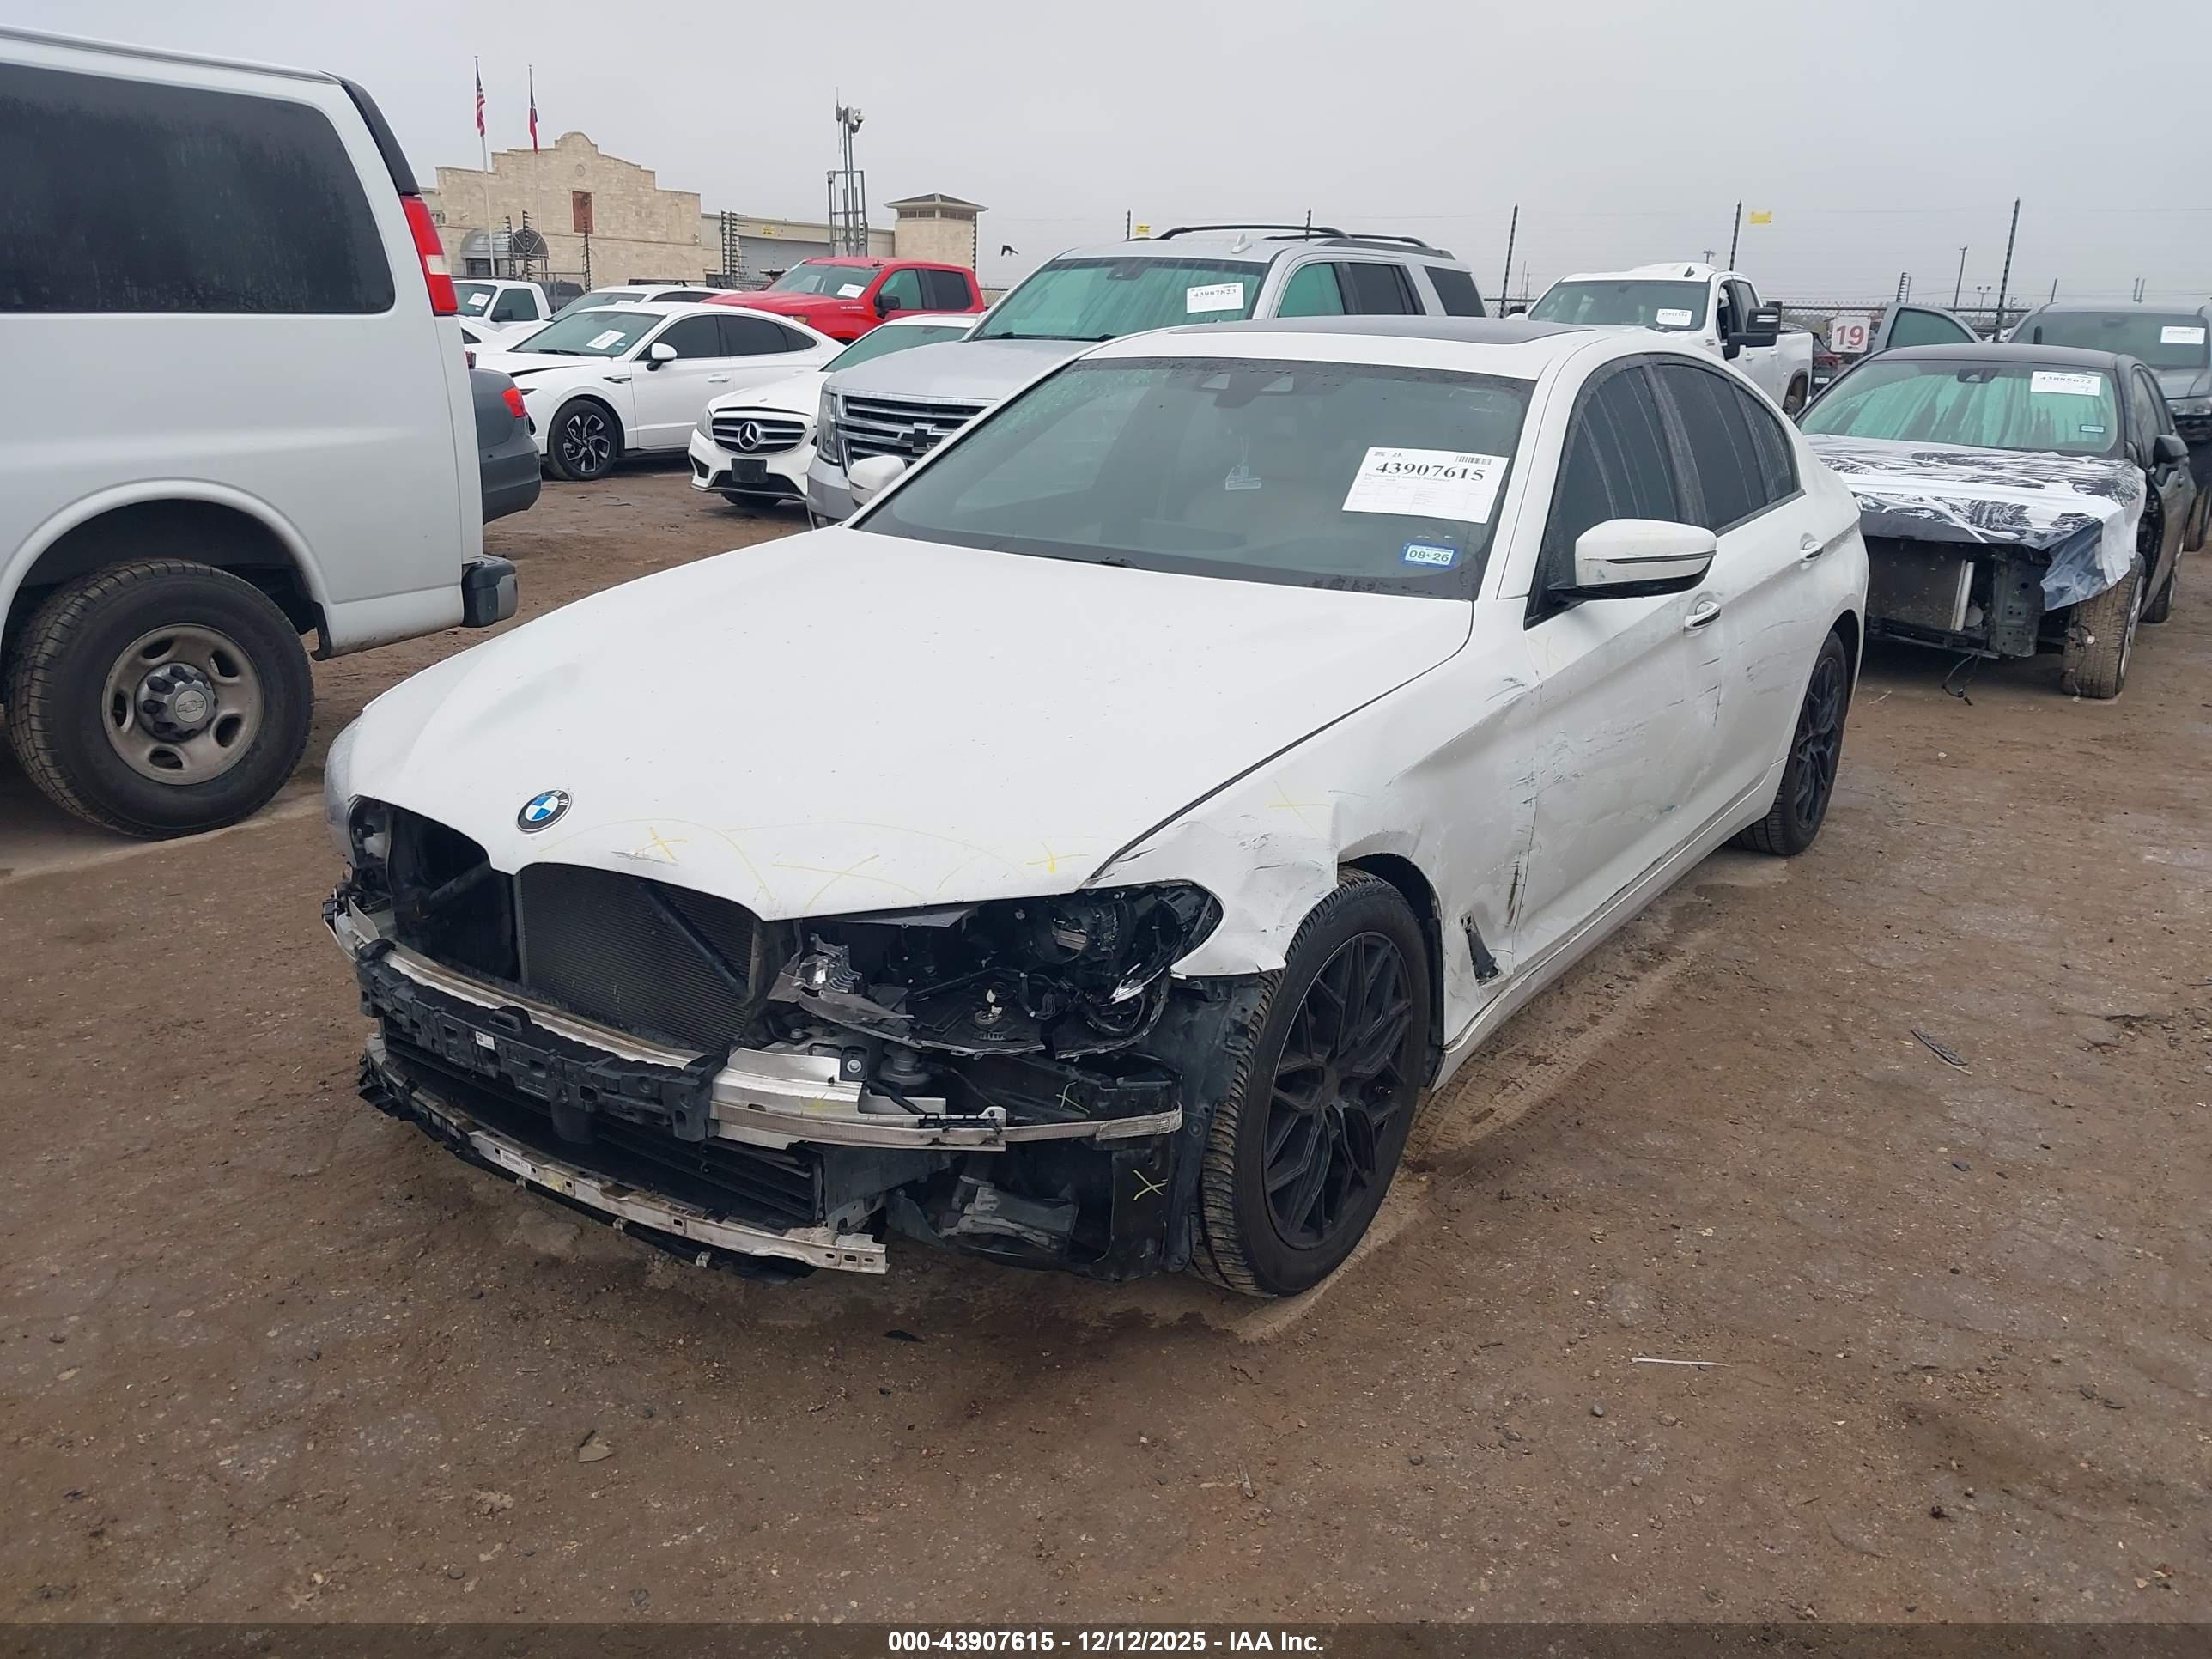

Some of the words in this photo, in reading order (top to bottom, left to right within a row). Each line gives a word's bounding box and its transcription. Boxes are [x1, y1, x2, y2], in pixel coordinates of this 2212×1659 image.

[1837, 325, 1864, 345] 19
[1376, 461, 1486, 482] 43907615
[1409, 550, 1426, 559] 08
[1432, 552, 1450, 562] 26
